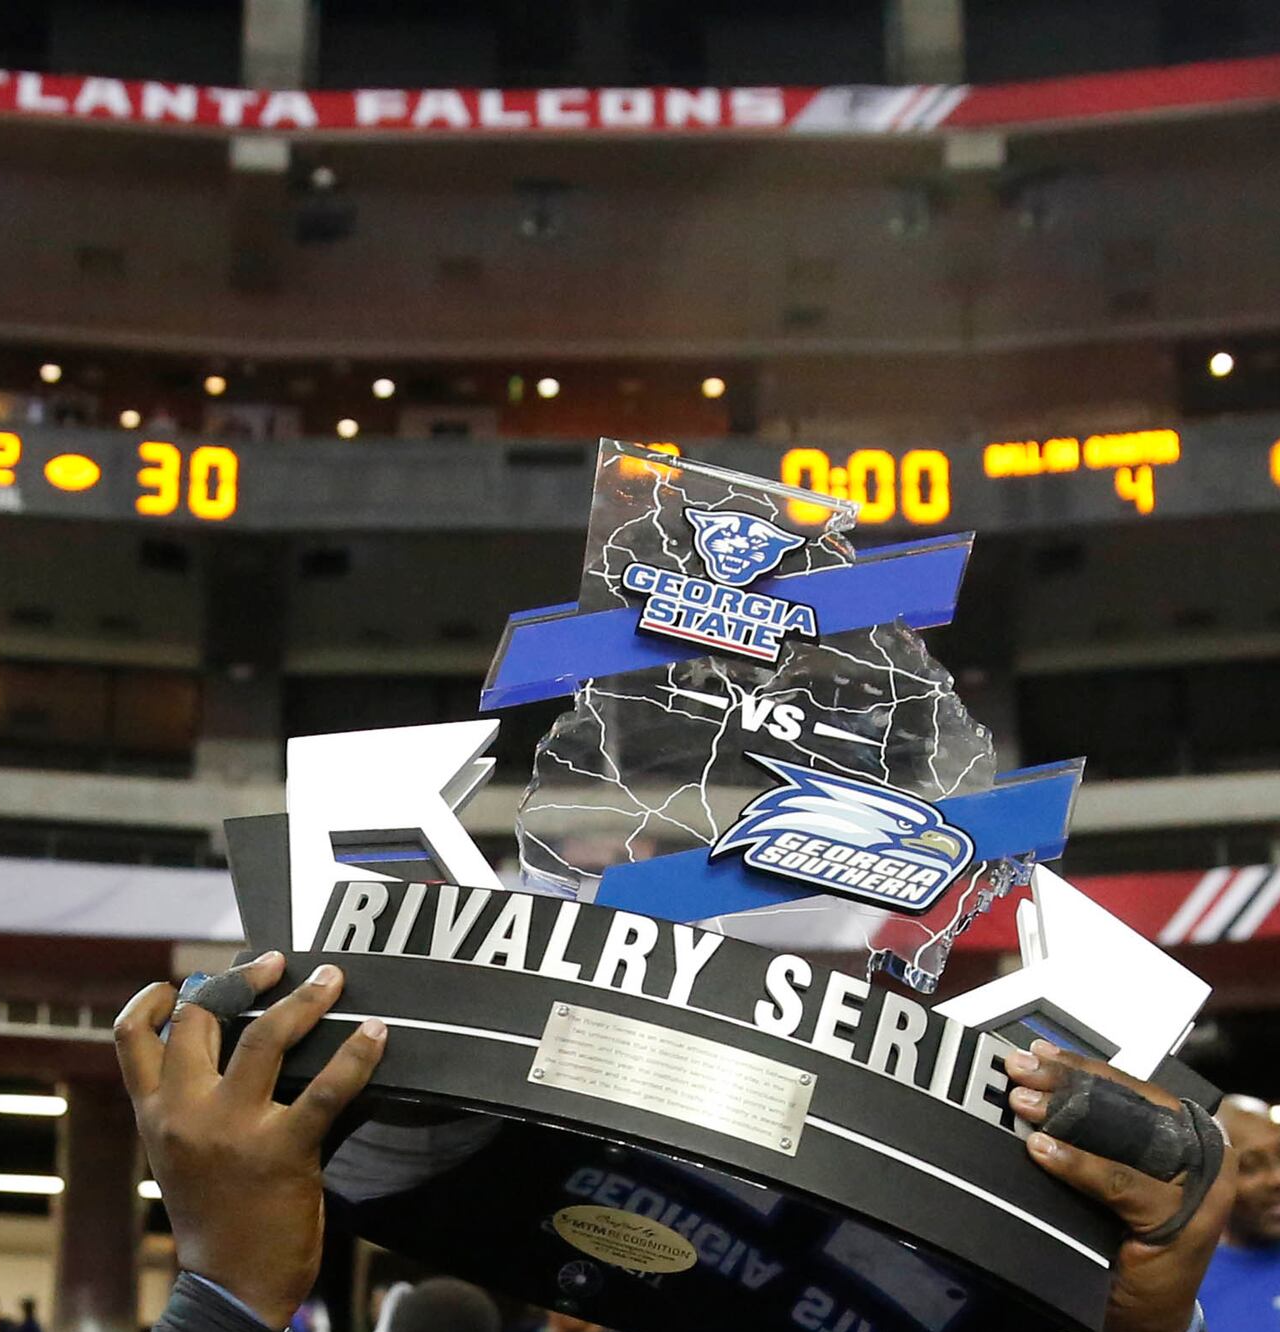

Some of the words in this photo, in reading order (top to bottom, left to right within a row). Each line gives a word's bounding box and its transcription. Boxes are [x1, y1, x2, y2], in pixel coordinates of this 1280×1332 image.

[354, 87, 784, 128] FALCONS
[135, 441, 238, 520] 30
[781, 448, 952, 525] 0:00
[1114, 464, 1155, 515] 4
[624, 563, 816, 638] GEORGIA
[646, 595, 782, 654] STATE
[740, 693, 806, 741] VS
[756, 847, 928, 902] SOUTHERN
[774, 832, 942, 887] GEORGIA
[322, 882, 725, 1006] RIVALRY
[754, 954, 1032, 1142] SERIE
